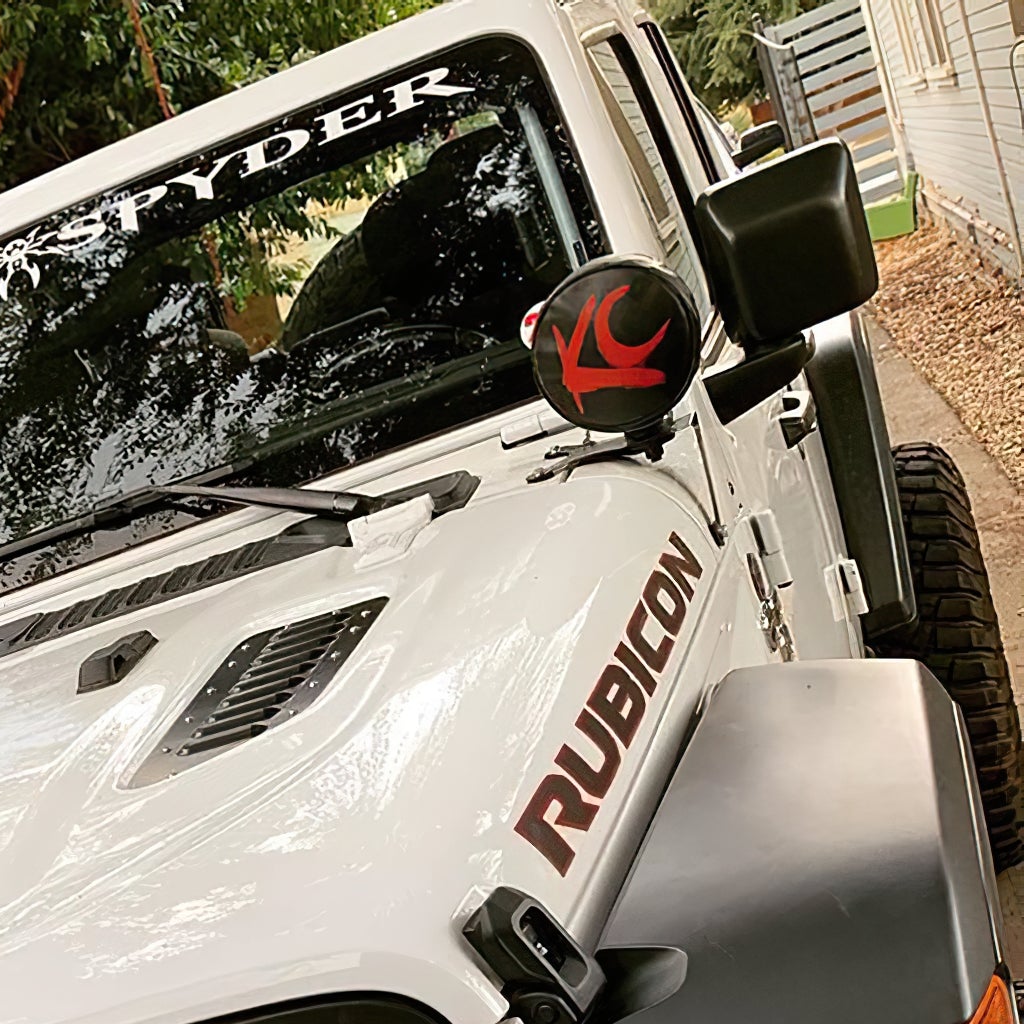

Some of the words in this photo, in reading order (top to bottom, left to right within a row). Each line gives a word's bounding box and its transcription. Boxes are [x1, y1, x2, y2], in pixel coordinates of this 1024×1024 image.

[57, 67, 475, 250] SPYDER
[552, 285, 671, 414] KC
[513, 530, 704, 878] RUBICON
